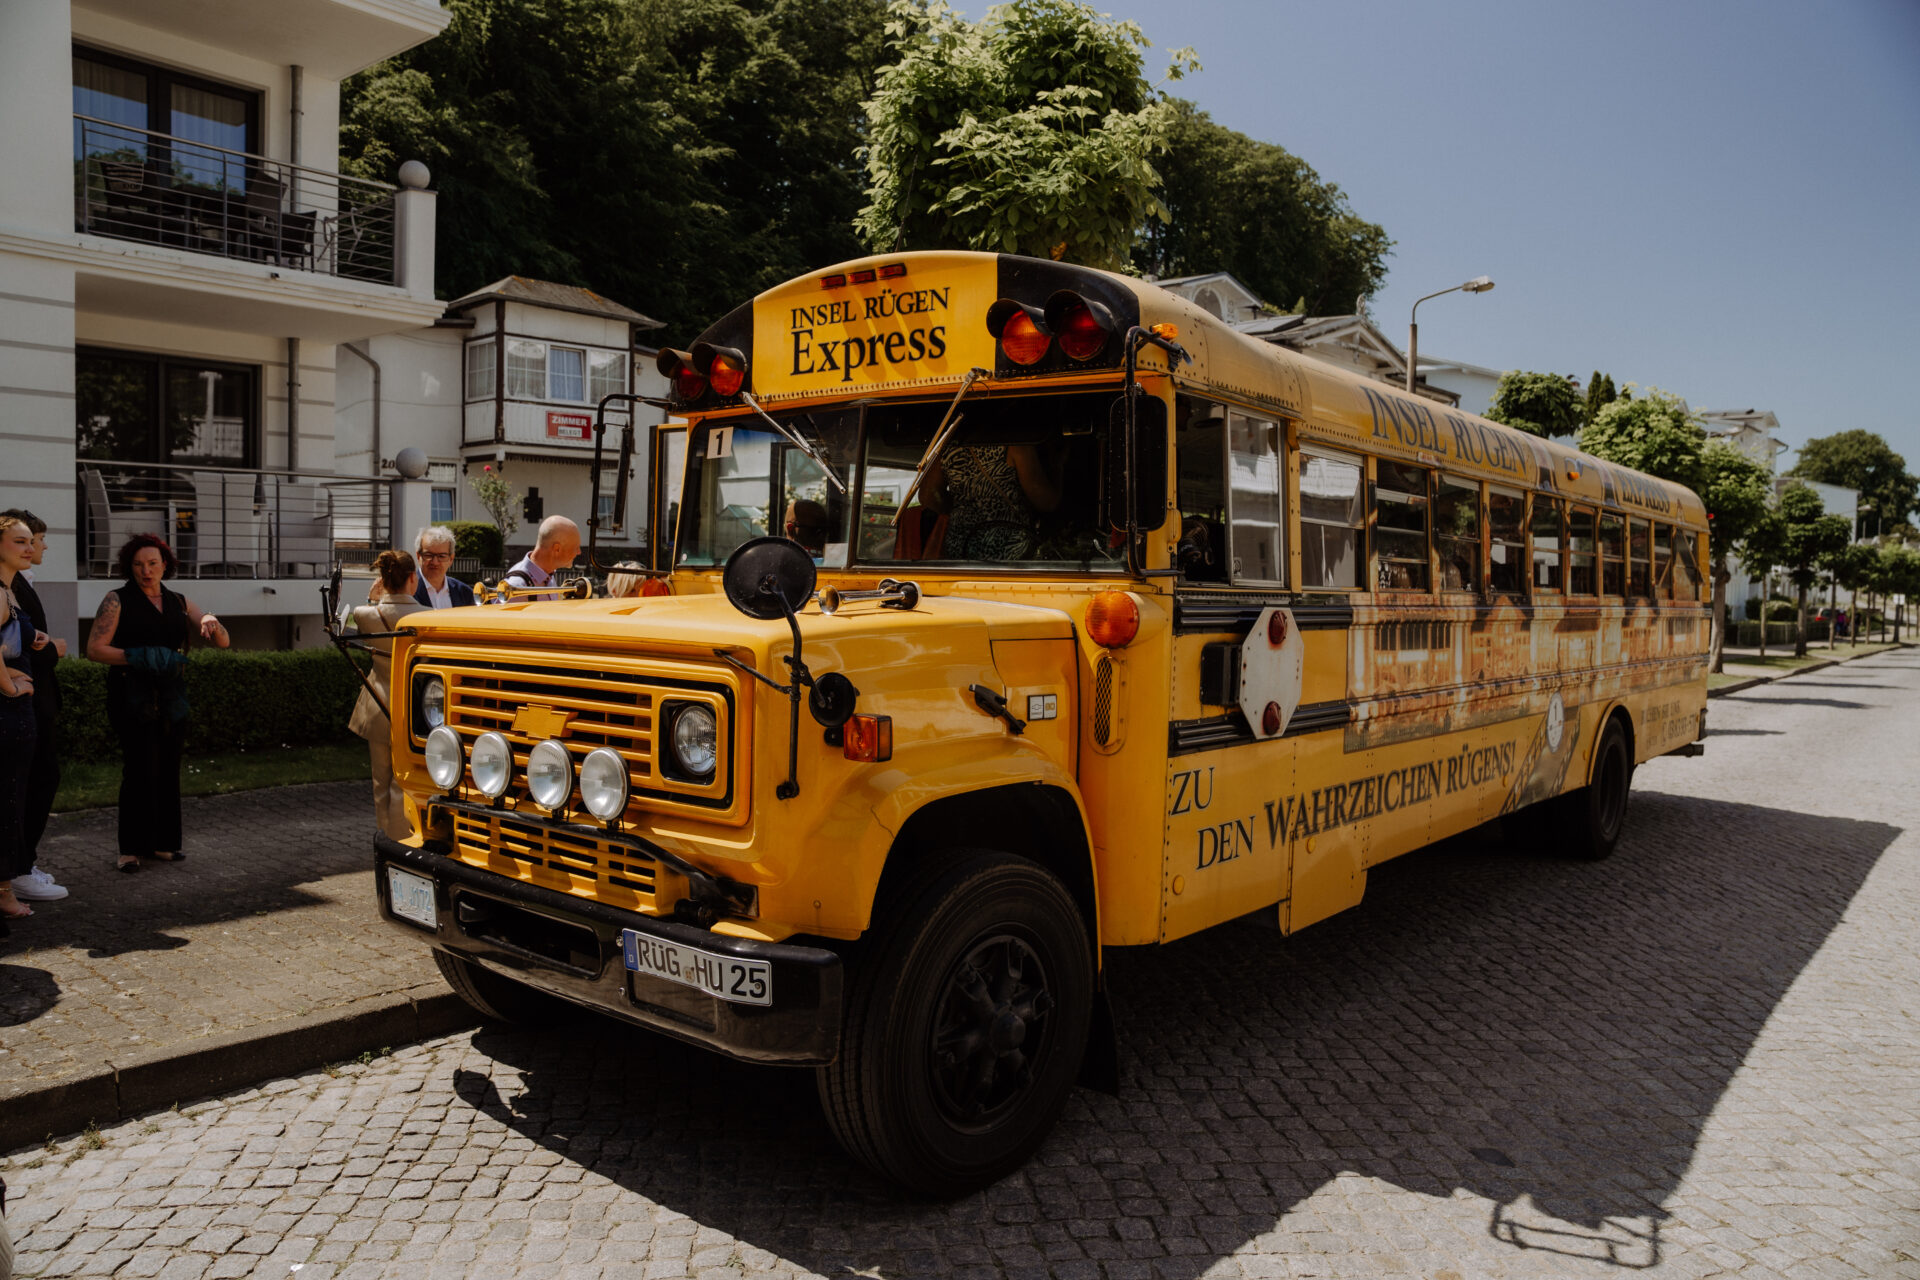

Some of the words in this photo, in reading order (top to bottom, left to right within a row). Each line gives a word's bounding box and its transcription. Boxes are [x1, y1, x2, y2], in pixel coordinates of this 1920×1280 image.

[791, 301, 857, 330] INSEL
[864, 287, 950, 320] RÜGEN
[790, 327, 946, 382] Express
[715, 430, 724, 456] 1
[1359, 385, 1447, 455] INSEL
[1445, 410, 1527, 475] RÜGEN
[1170, 766, 1215, 816] ZU
[1196, 815, 1256, 871] DEN
[1264, 758, 1444, 850] WAHRZEICHEN
[1446, 739, 1517, 795] RÜGENS!
[637, 938, 681, 977] RÜG
[730, 965, 766, 998] 25
